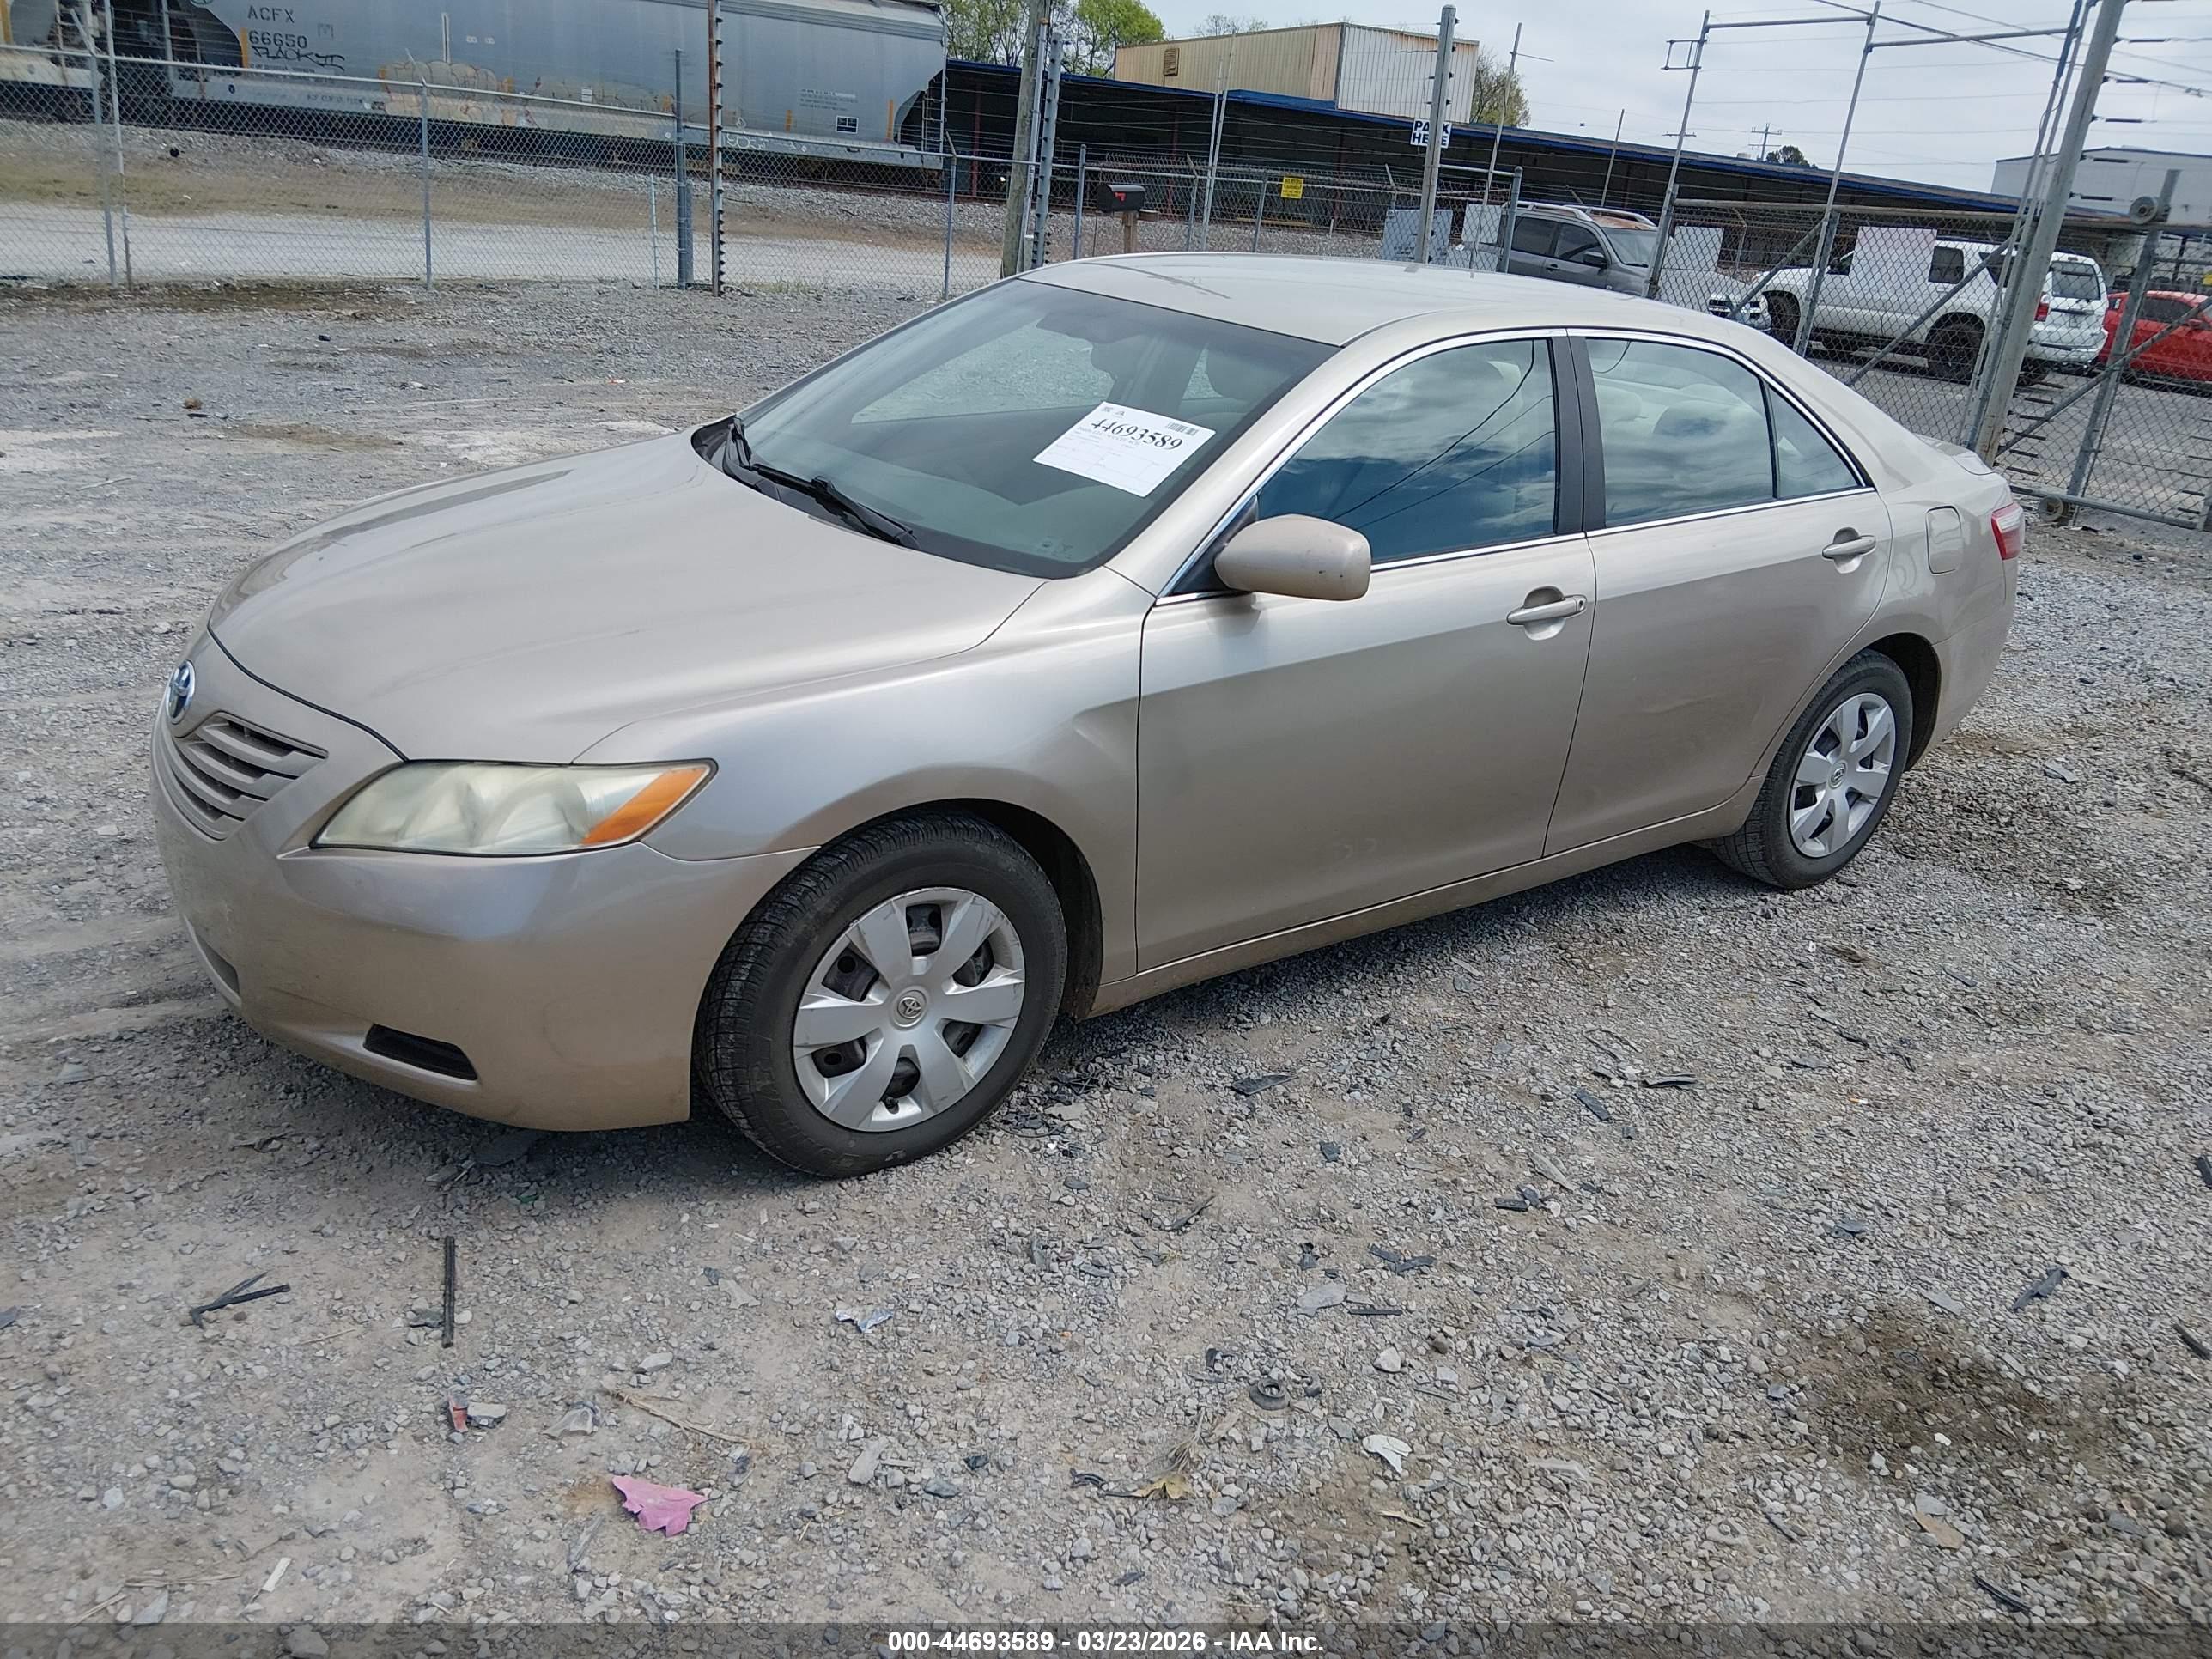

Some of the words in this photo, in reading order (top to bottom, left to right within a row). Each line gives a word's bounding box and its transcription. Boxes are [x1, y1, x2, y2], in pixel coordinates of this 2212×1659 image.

[247, 5, 295, 23] ACFX
[248, 30, 307, 49] 66650
[1413, 120, 1449, 134] PAK
[1412, 132, 1449, 146] HEE
[1091, 418, 1183, 450] 44693589
